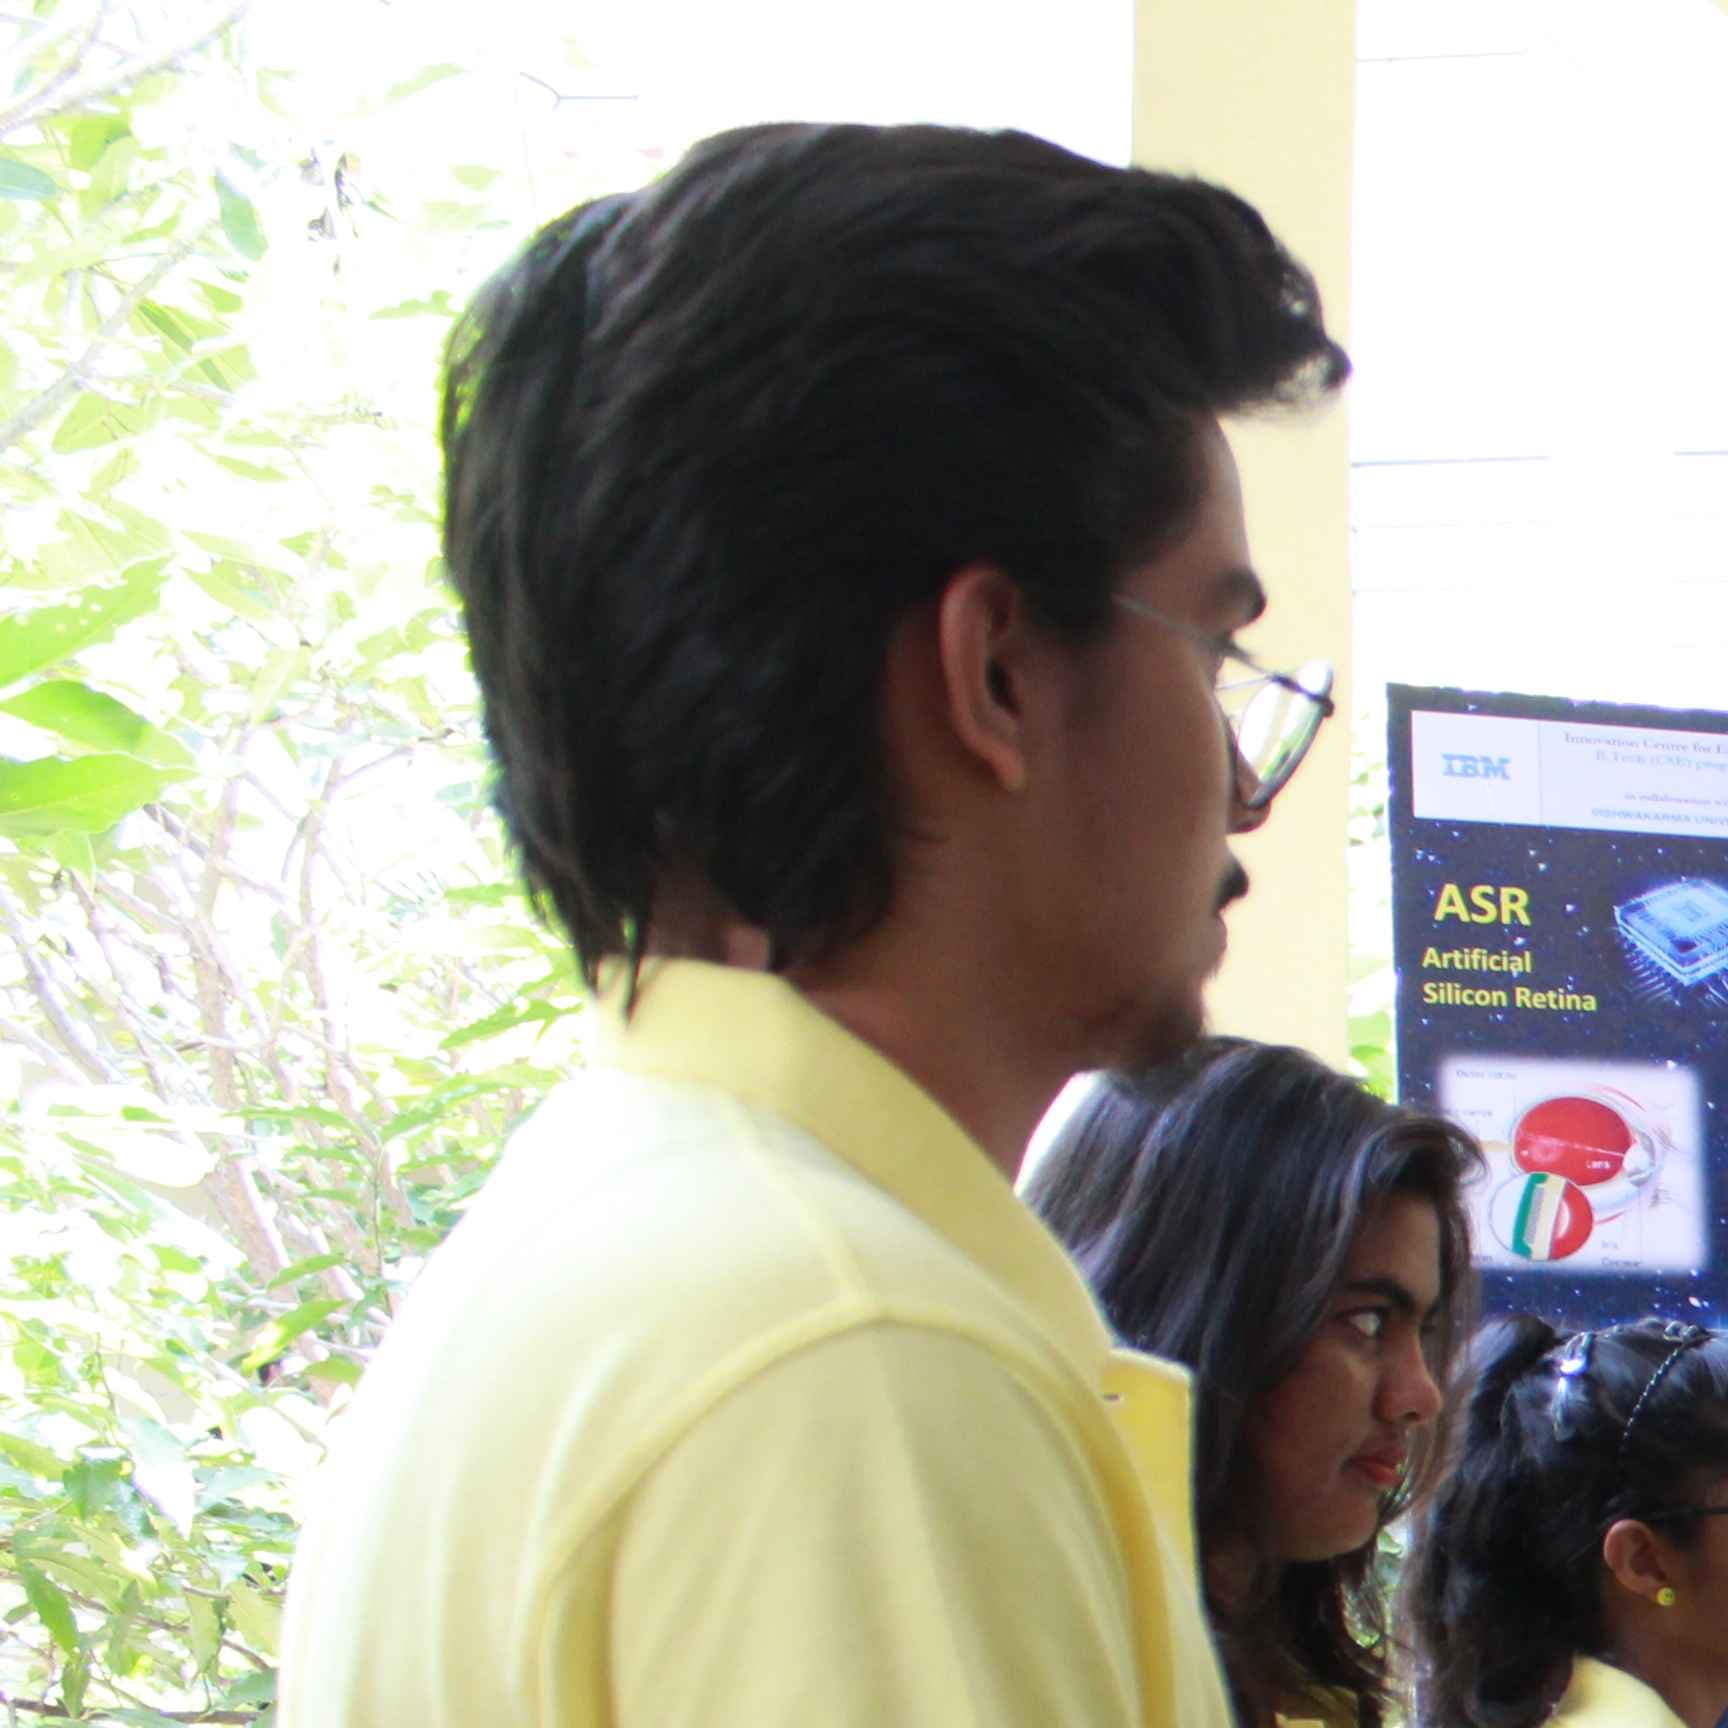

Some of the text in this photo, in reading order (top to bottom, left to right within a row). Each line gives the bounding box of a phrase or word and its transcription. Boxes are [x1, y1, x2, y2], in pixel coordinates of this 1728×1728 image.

[1564, 733, 1640, 748] Innovation
[1643, 739, 1690, 751] Centre
[1693, 742, 1711, 753] for
[1443, 754, 1511, 780] IBM
[1434, 883, 1532, 926] ASR
[1423, 947, 1532, 973] Artificial
[1423, 983, 1596, 1012] Silicon Retina
